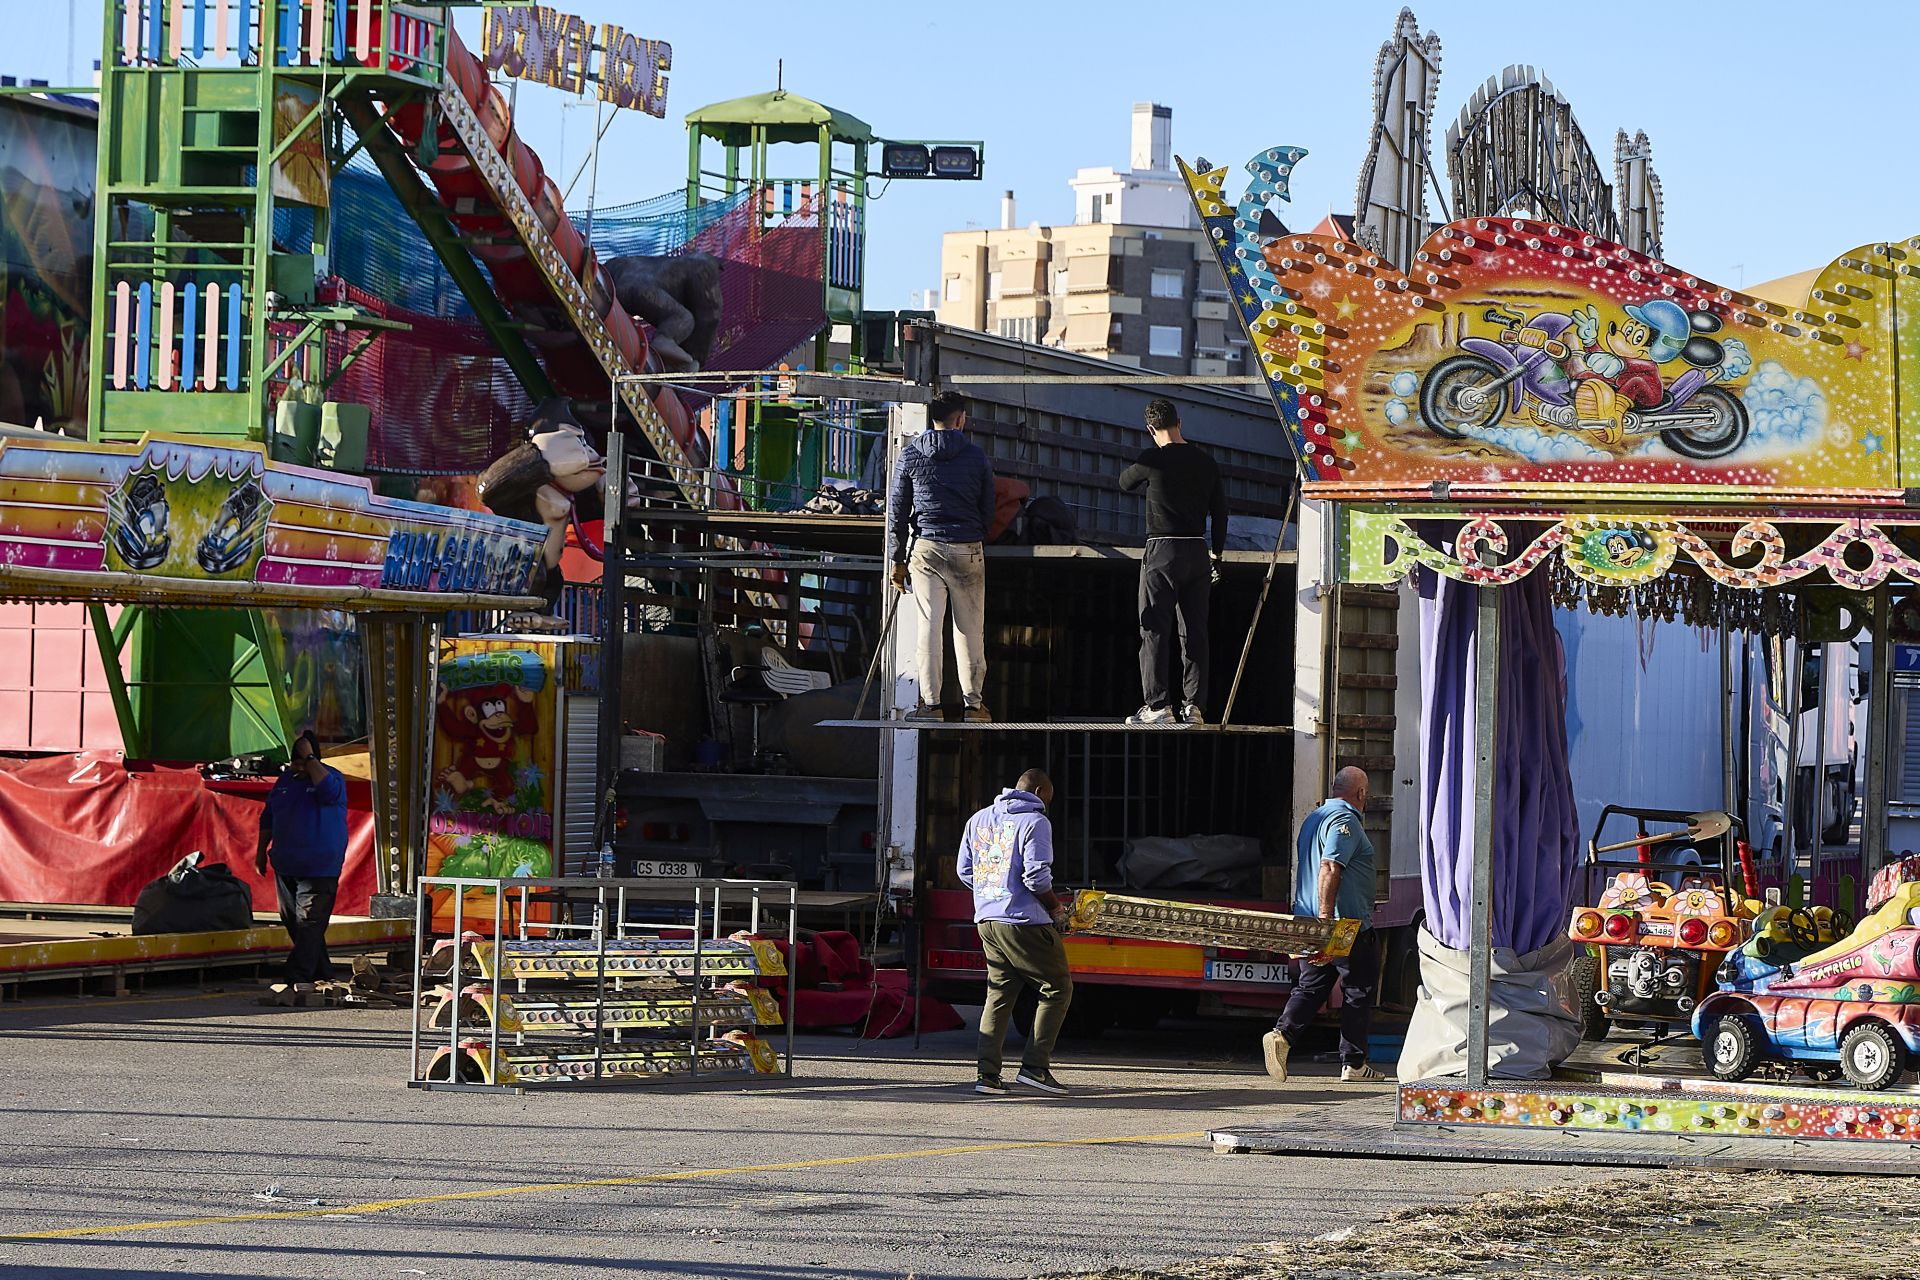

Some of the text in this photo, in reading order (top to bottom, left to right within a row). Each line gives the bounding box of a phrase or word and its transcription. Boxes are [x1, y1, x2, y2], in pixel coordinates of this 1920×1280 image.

[483, 6, 672, 119] DONKEY KONG
[439, 651, 525, 687] TICKETS
[638, 862, 653, 875] CS
[658, 863, 688, 876] 0338
[1654, 928, 1673, 936] 1485
[1215, 962, 1254, 980] 1576
[1810, 955, 1863, 982] PATRICIO
